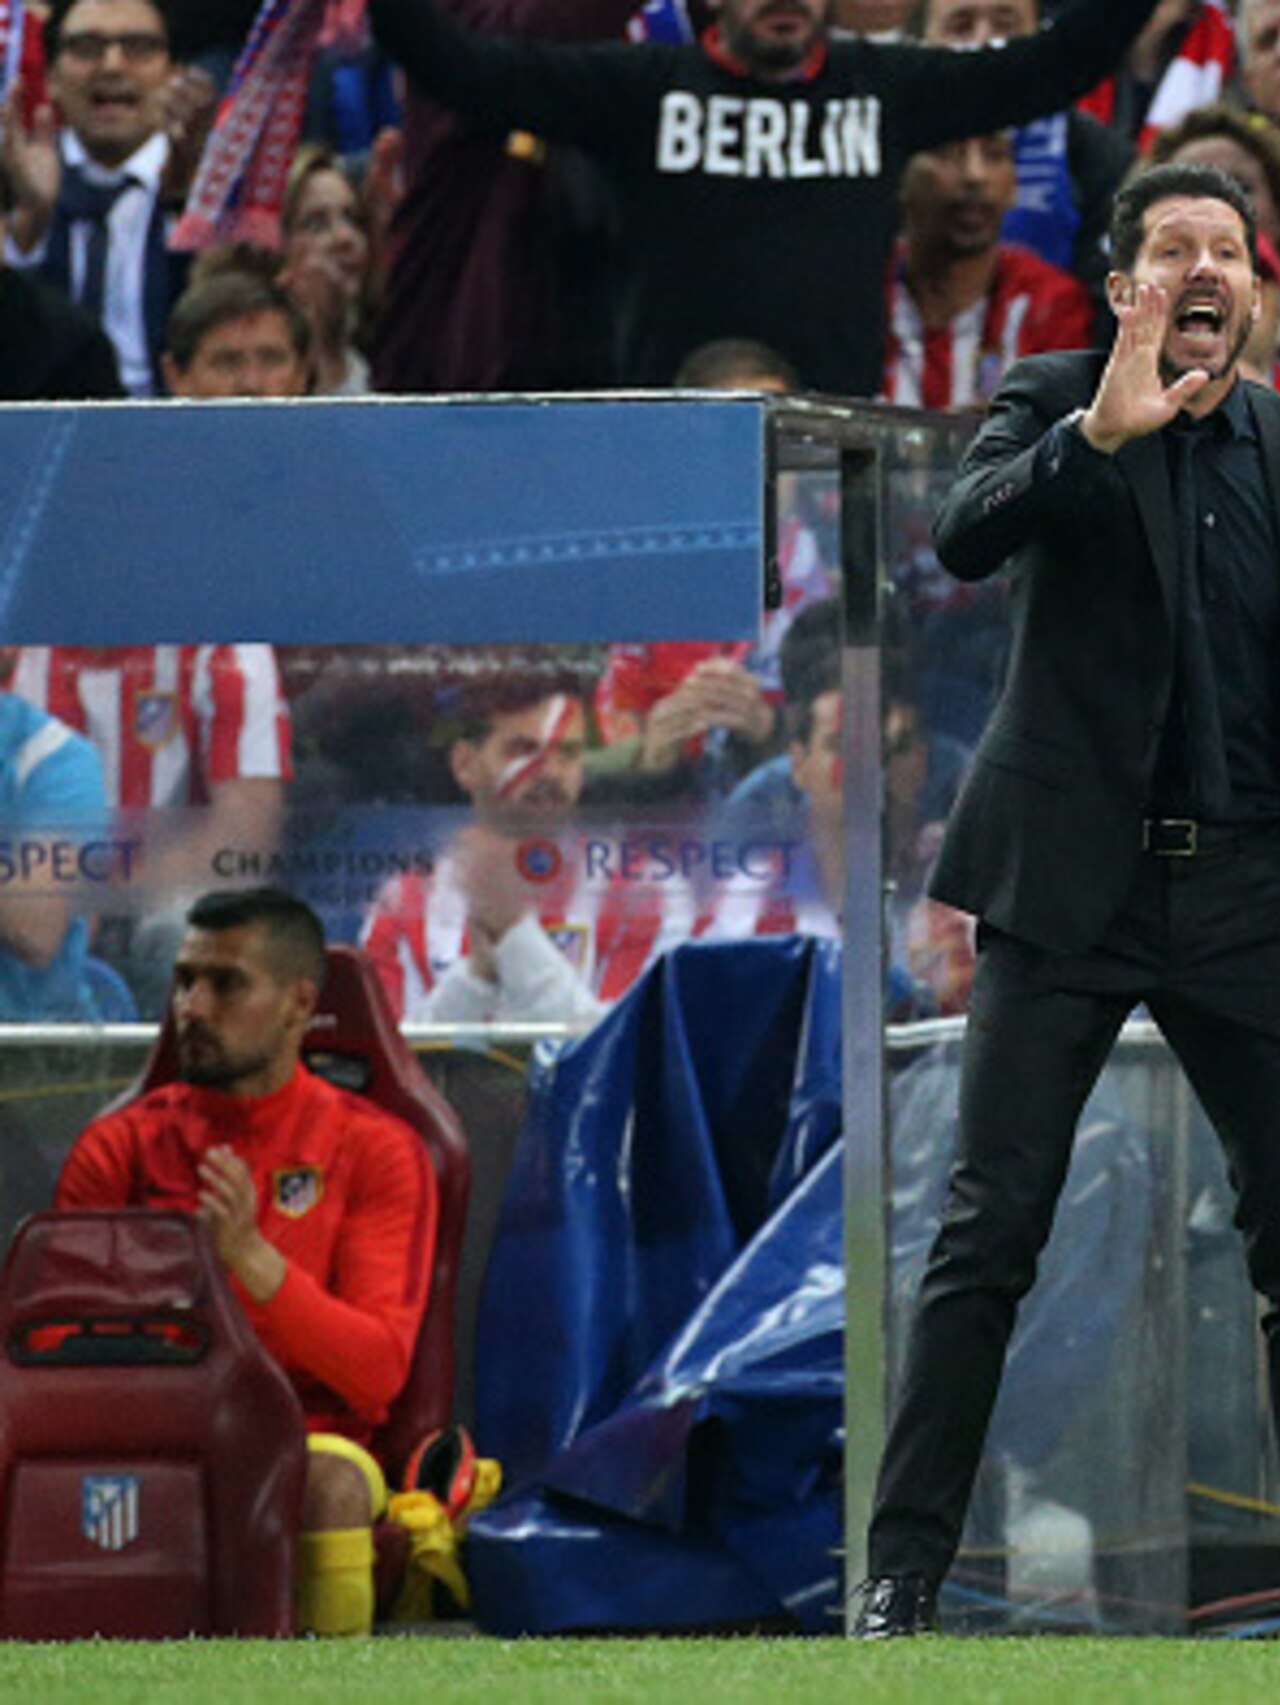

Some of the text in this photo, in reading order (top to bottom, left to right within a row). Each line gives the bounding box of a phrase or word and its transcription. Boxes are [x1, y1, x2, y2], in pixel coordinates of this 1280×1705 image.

[656, 91, 880, 178] BERLIN
[211, 849, 435, 878] CHAMPIONS
[586, 840, 796, 881] RESPECT
